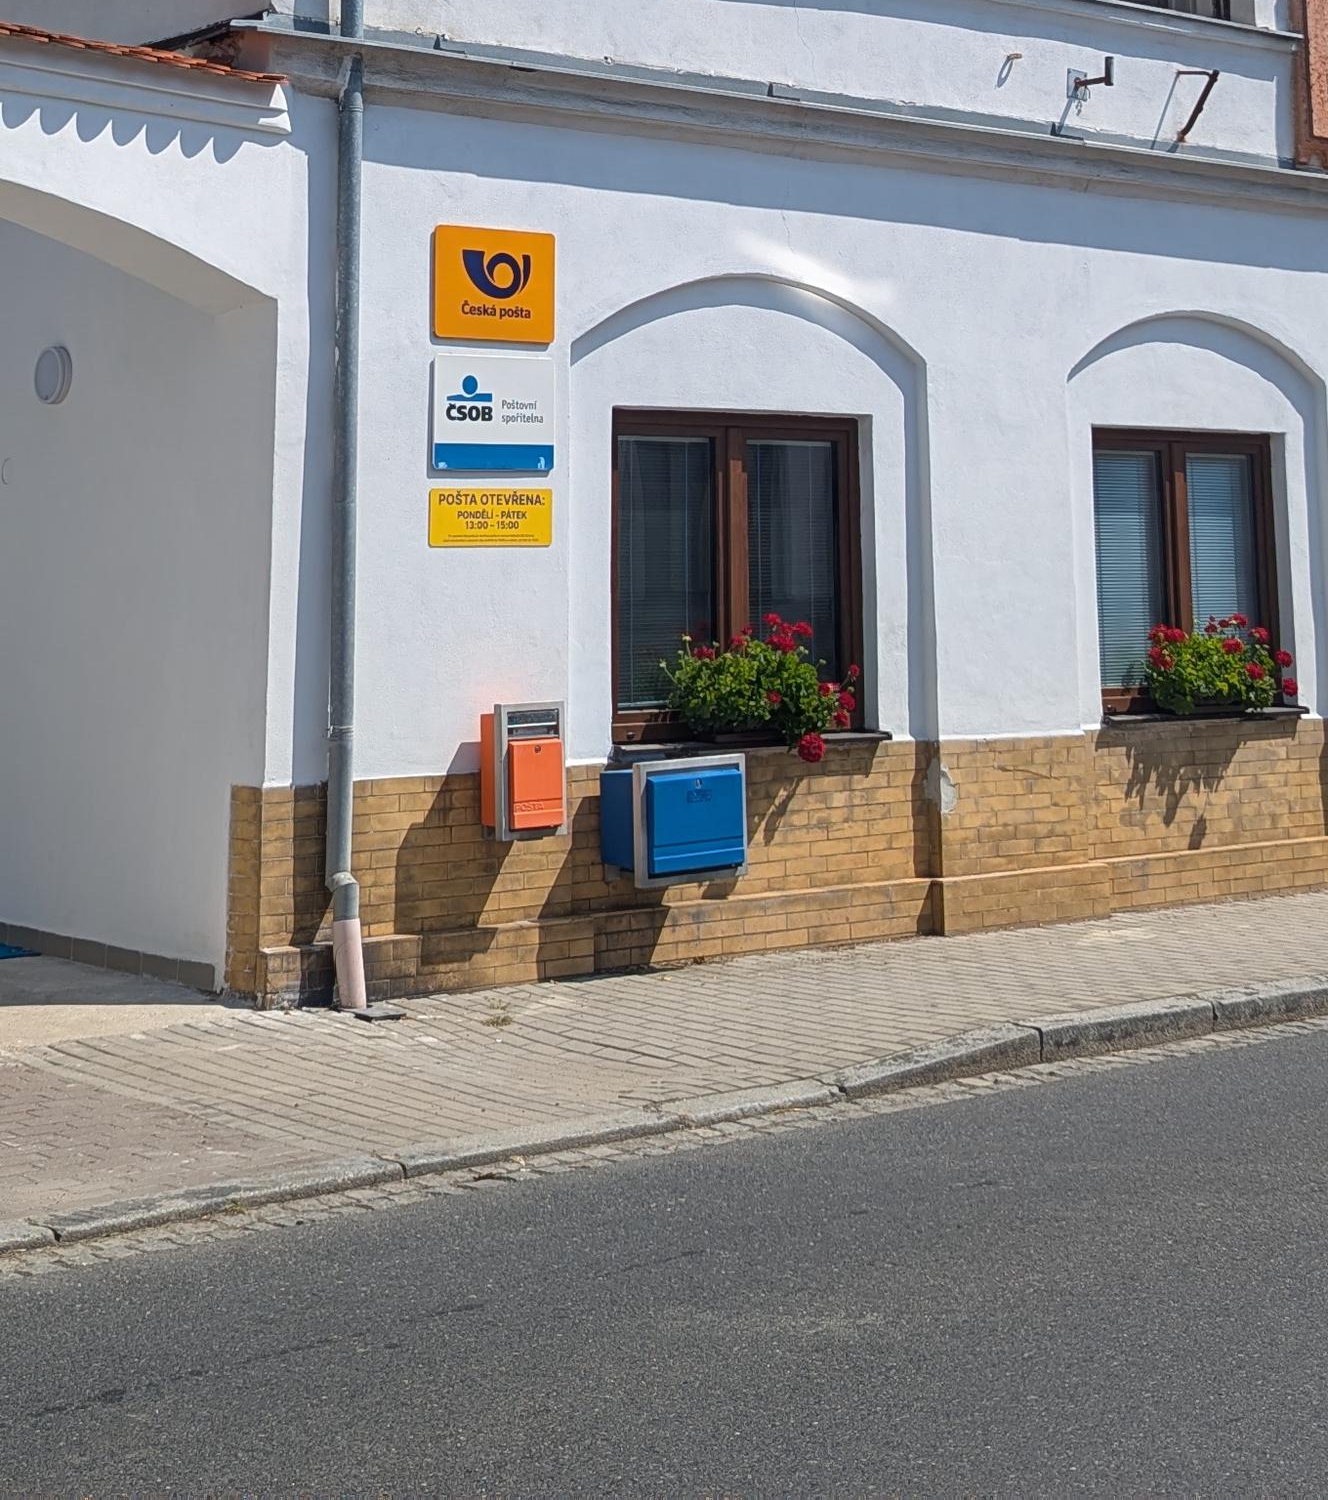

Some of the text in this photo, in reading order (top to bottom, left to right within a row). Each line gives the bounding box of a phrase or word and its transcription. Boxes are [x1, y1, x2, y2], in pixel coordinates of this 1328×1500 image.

[461, 300, 531, 320] Česká pošta
[501, 400, 537, 410] Poštovní
[446, 403, 493, 421] ČSOB
[501, 412, 544, 425] spořitelna
[438, 490, 545, 506] POŠTA OTEVŘENA:
[457, 509, 493, 520] PONDĚLÍ
[500, 509, 527, 520] PÁTEK
[465, 521, 488, 530] 13:00
[497, 521, 519, 530] 15:00
